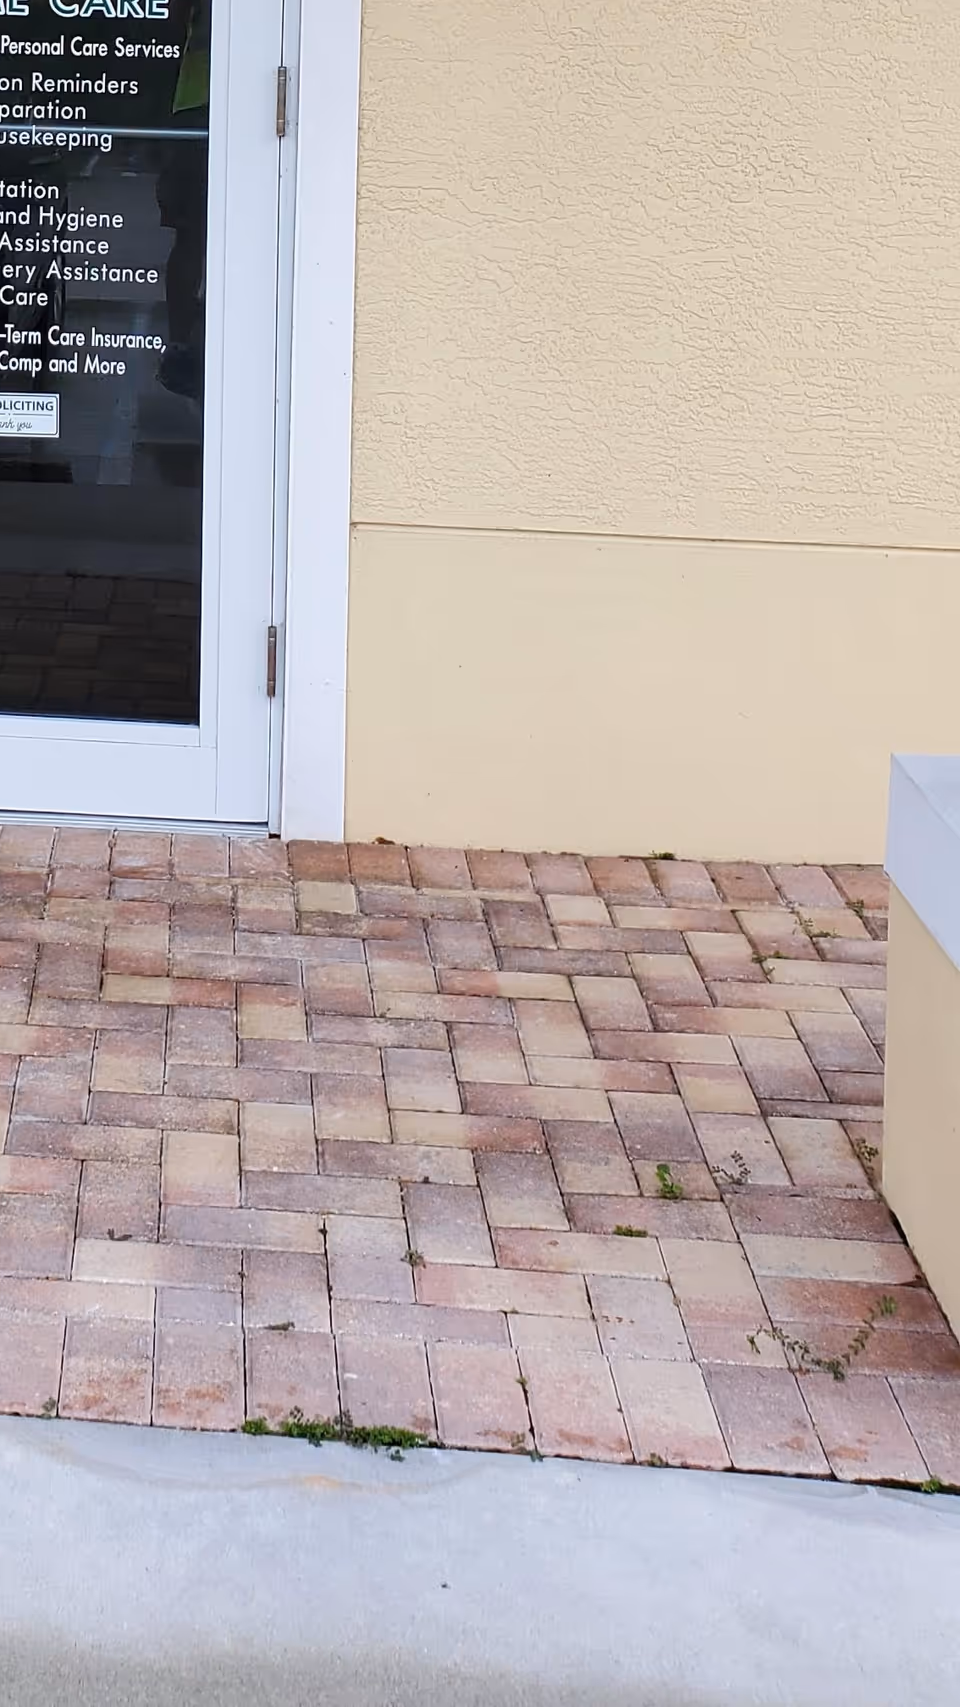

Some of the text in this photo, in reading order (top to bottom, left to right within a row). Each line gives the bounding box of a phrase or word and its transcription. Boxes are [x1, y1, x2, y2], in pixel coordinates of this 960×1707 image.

[0, 36, 65, 56] Personal
[70, 37, 108, 57] Care
[114, 38, 180, 59] Services
[31, 73, 139, 95] Reminders
[39, 209, 124, 233] Hygiene
[46, 262, 159, 283] Assistance
[0, 285, 49, 307] Care
[48, 327, 85, 347] Care
[91, 329, 167, 353] Insurance,
[49, 353, 78, 374] and
[84, 356, 126, 375] More
[16, 420, 32, 431] you
